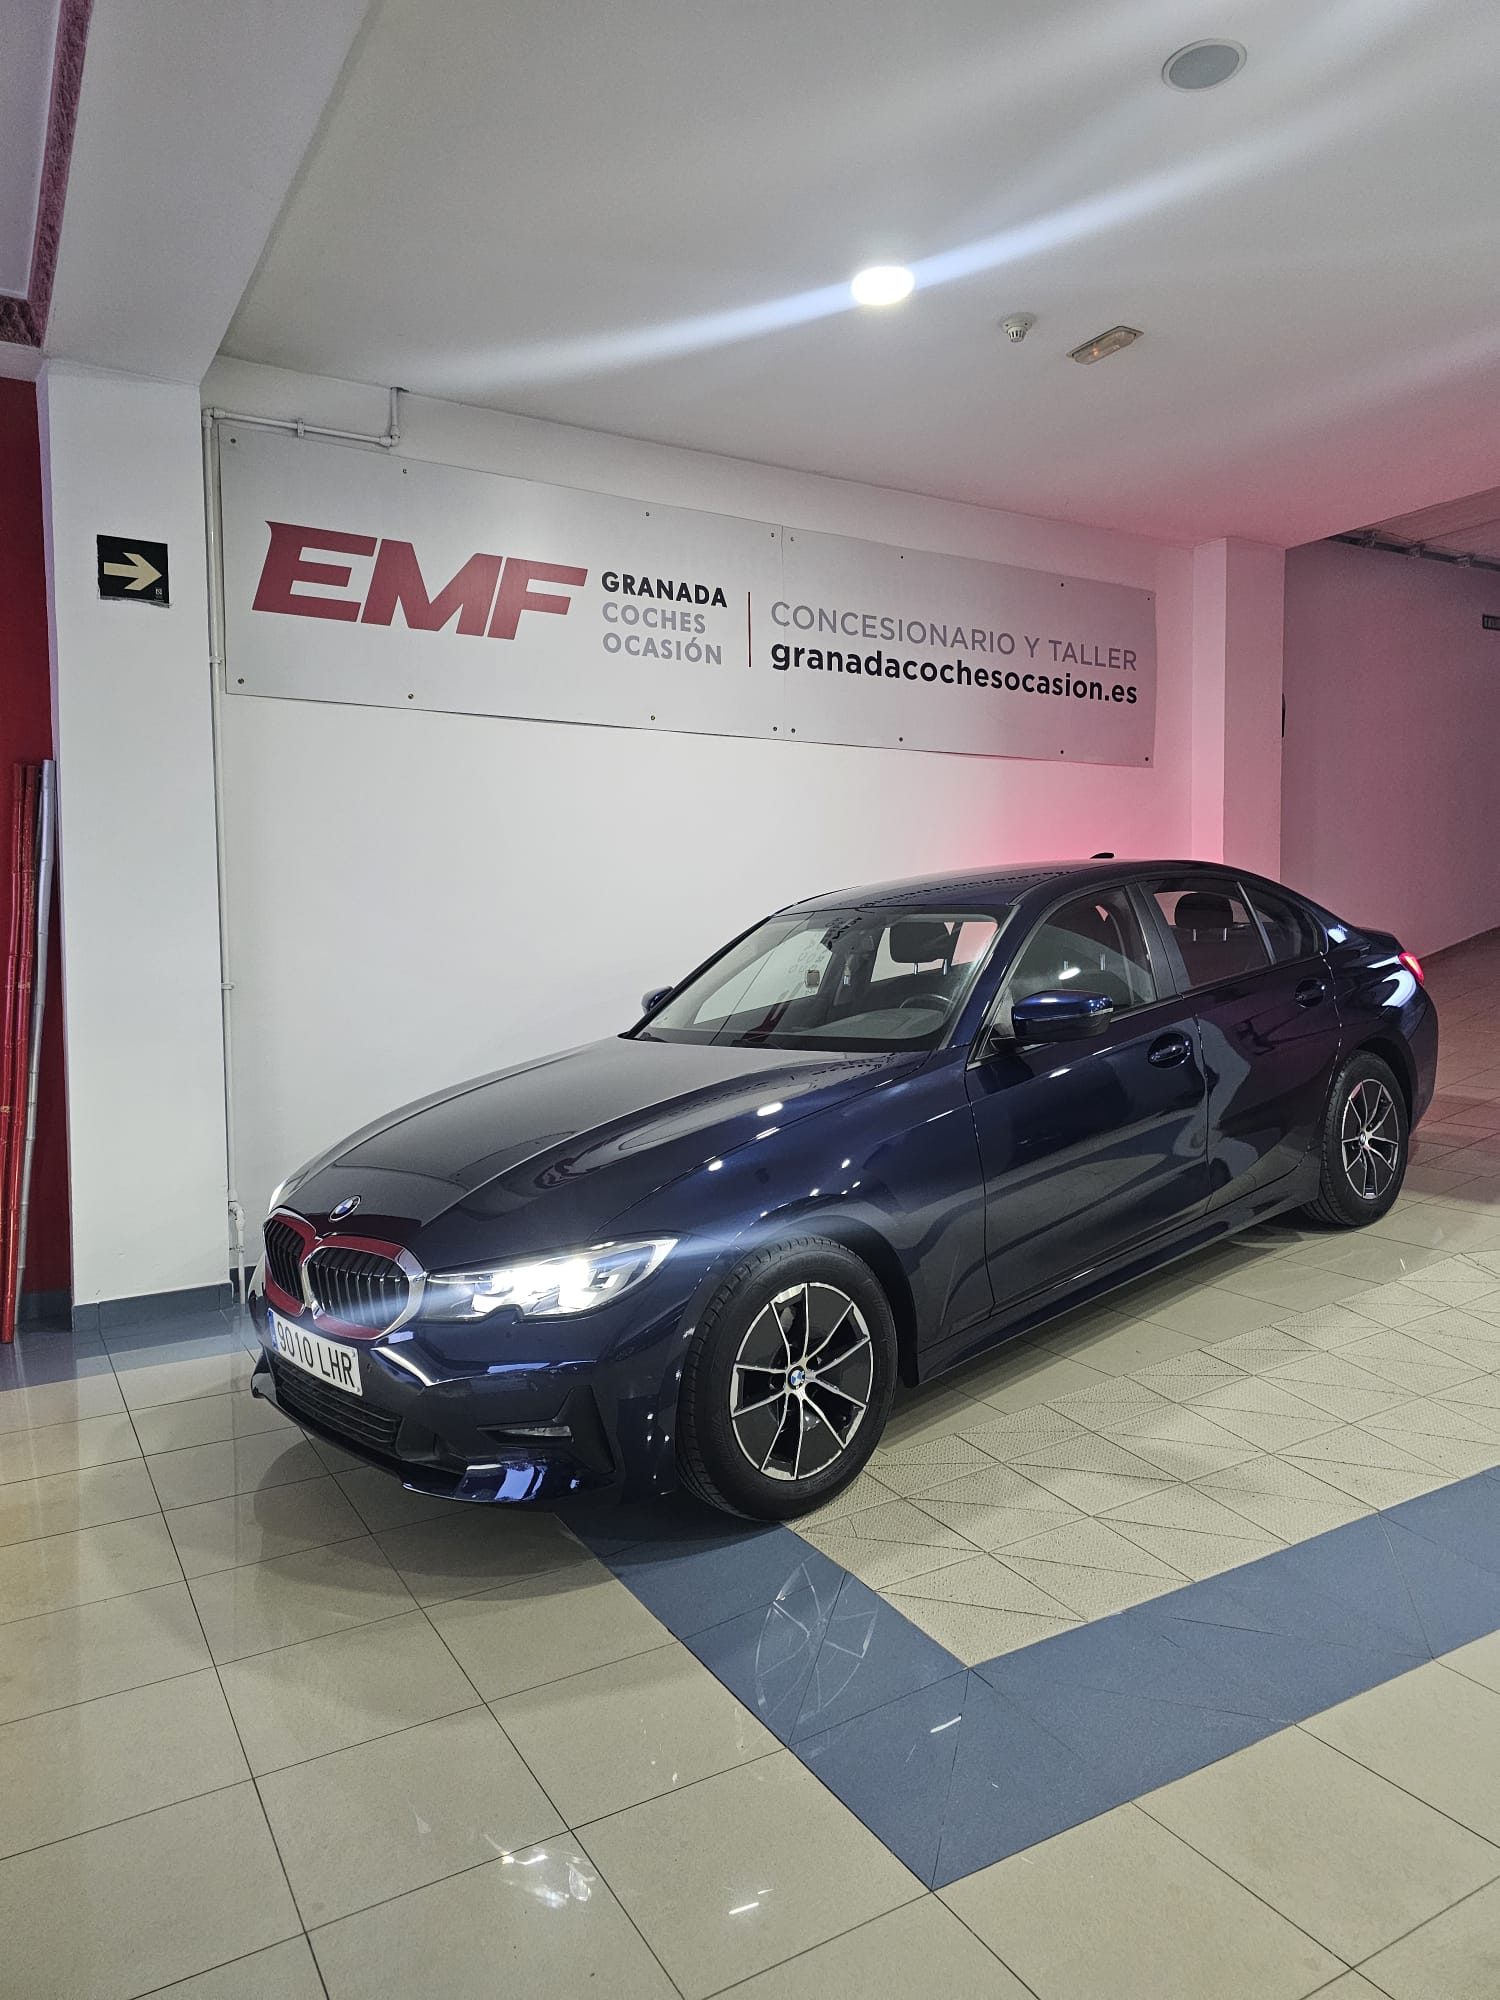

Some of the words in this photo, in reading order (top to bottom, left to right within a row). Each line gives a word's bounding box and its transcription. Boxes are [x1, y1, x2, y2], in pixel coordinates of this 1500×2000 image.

[252, 520, 588, 640] EMF
[601, 571, 728, 608] GRANADA
[602, 601, 706, 634] COCHES
[771, 601, 1016, 655] CONCESIONARIO
[1024, 635, 1041, 658] Y
[1048, 639, 1138, 671] TALLER
[602, 632, 722, 665] OCASIÓN
[771, 643, 1138, 704] granadacochesocasion.es
[277, 1320, 314, 1368] 9010
[316, 1342, 355, 1388] LHR
